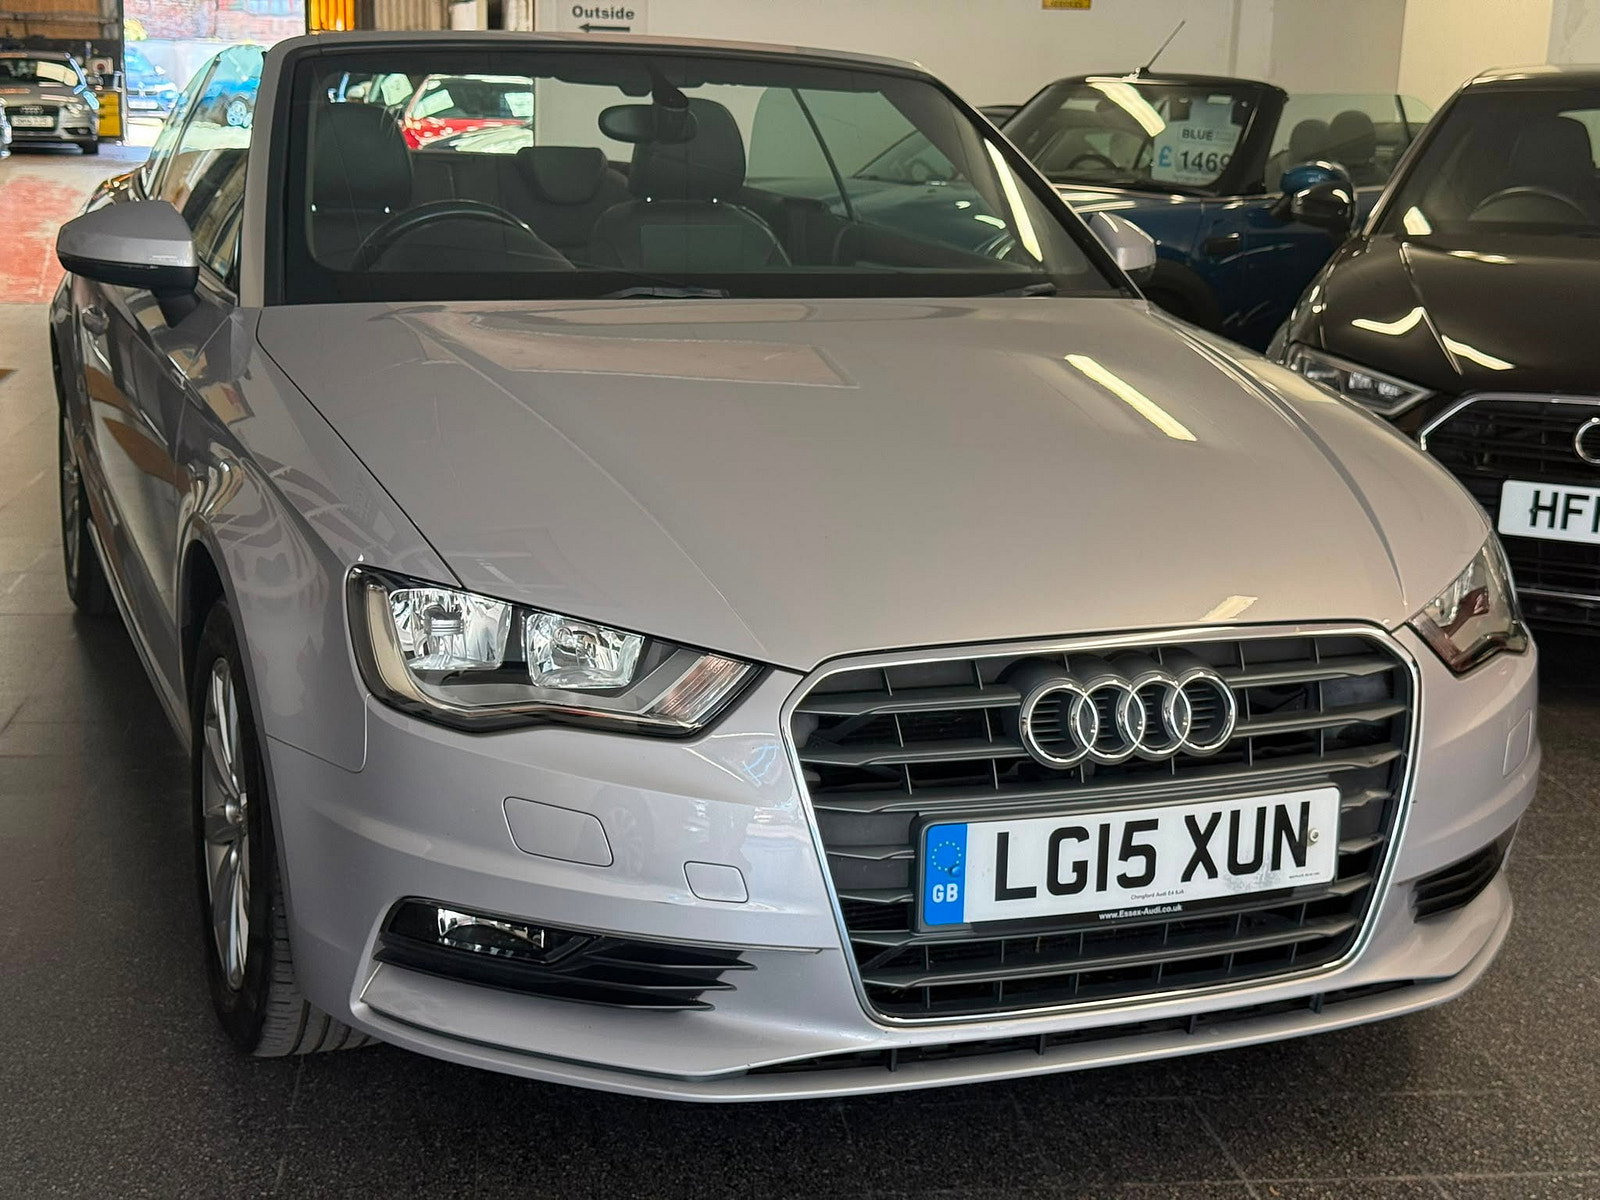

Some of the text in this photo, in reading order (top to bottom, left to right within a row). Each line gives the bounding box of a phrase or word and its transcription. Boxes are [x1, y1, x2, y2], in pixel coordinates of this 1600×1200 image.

[572, 5, 635, 20] Outside
[1182, 129, 1213, 141] BLUE
[1158, 146, 1172, 168] £
[995, 801, 1310, 902] LG15 XUN
[932, 883, 958, 903] GB
[1098, 904, 1183, 920] www.Essex-Audi.co.uk
